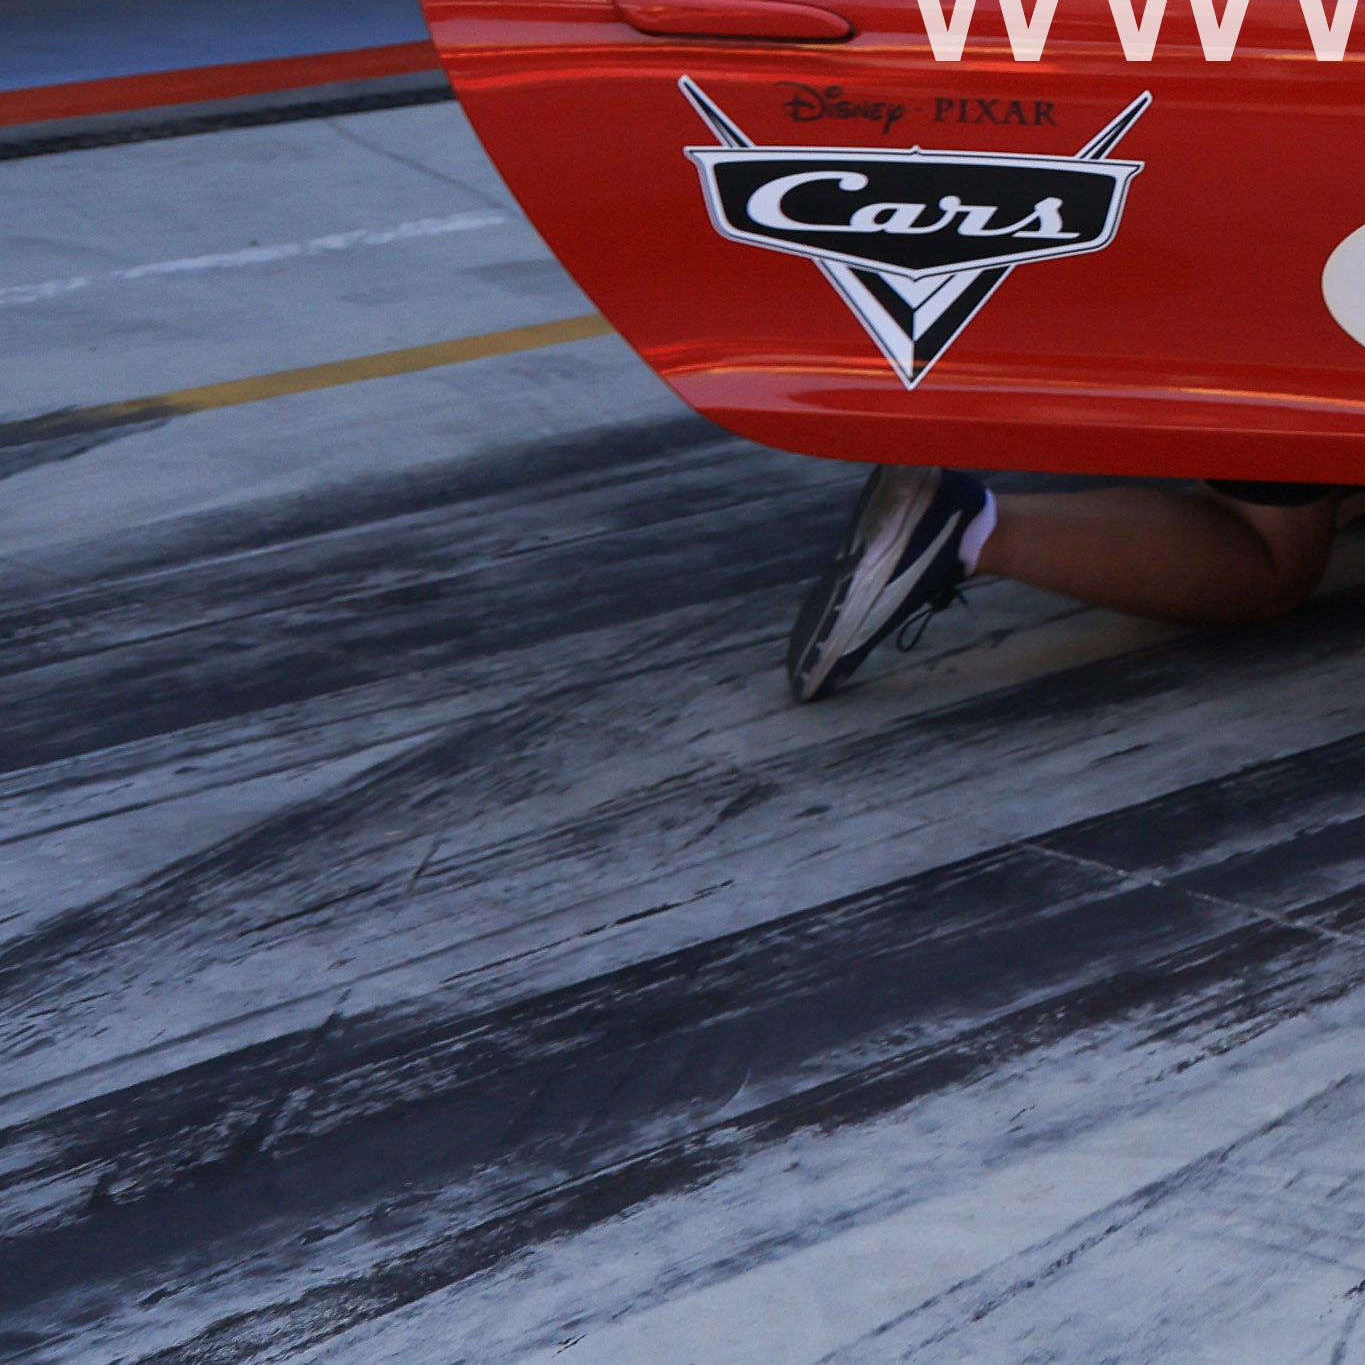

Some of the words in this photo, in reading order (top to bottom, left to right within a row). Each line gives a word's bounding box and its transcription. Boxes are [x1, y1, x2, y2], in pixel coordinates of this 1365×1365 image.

[774, 81, 908, 134] Disney
[933, 97, 1057, 127] PIXAR
[746, 170, 1081, 240] Cars
